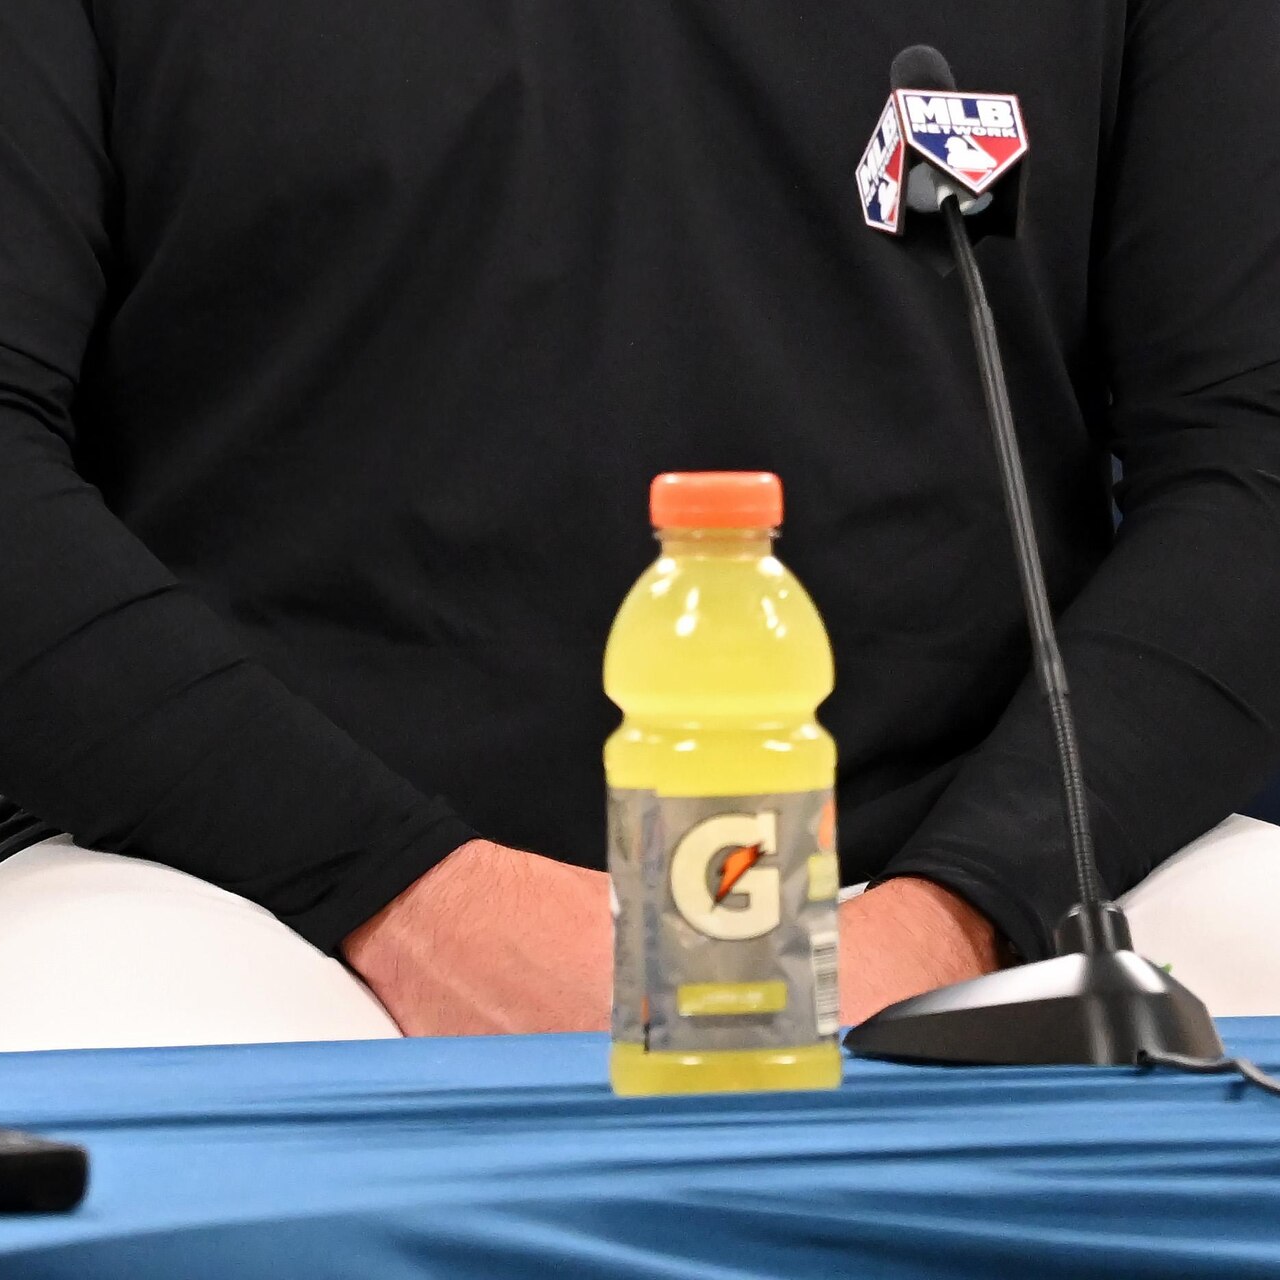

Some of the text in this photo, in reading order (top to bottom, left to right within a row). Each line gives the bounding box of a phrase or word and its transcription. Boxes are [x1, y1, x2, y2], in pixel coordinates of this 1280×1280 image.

[905, 96, 1015, 127] MLB
[912, 123, 1018, 137] NETWORK
[671, 812, 780, 941] G
